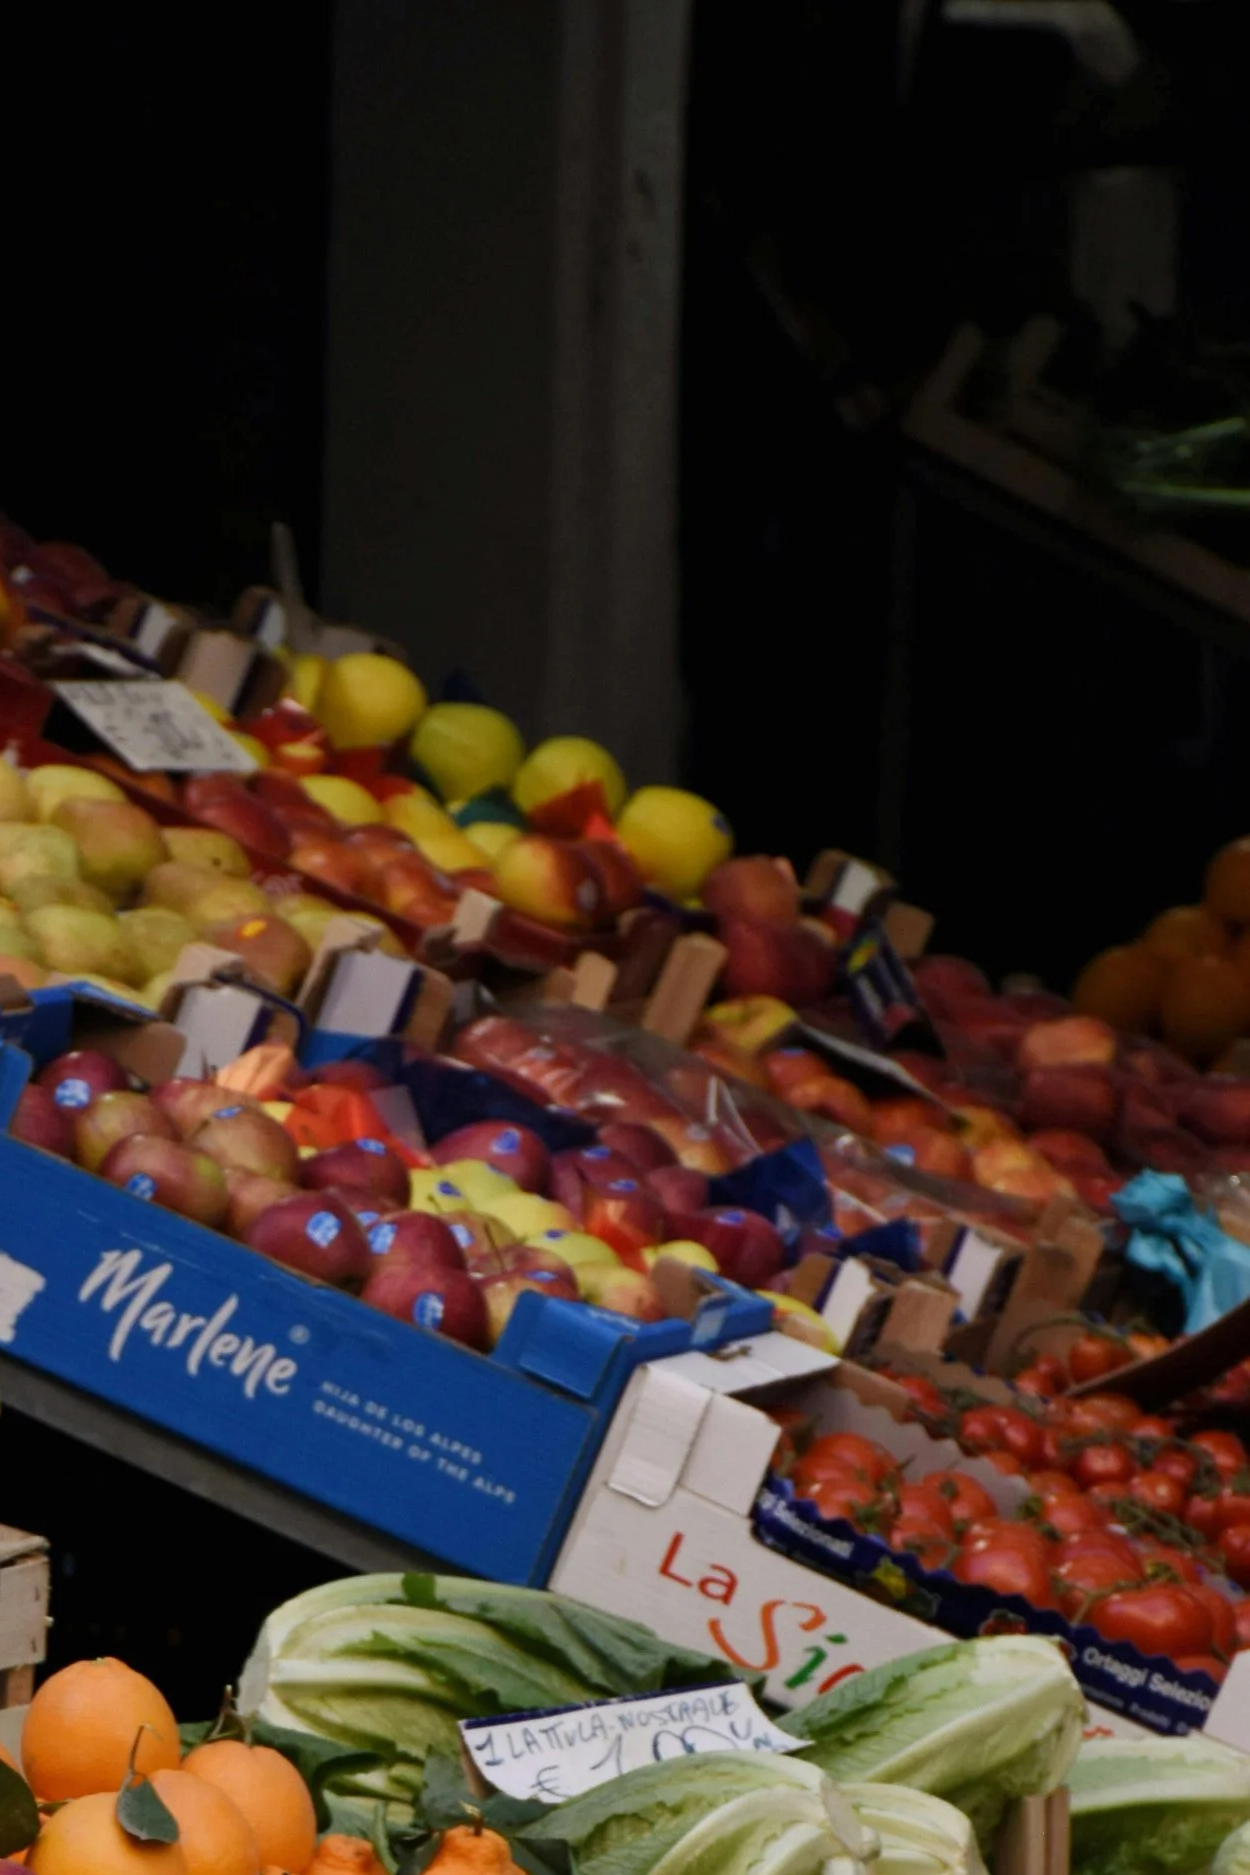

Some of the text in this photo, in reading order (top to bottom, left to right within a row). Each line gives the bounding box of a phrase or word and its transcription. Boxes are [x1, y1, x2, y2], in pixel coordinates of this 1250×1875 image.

[78, 1248, 298, 1399] Marlene
[391, 1414, 426, 1438] LOS
[430, 1432, 483, 1465] ALPES
[437, 1457, 470, 1481] THE
[473, 1476, 517, 1505] ALPS
[659, 1532, 738, 1605] La
